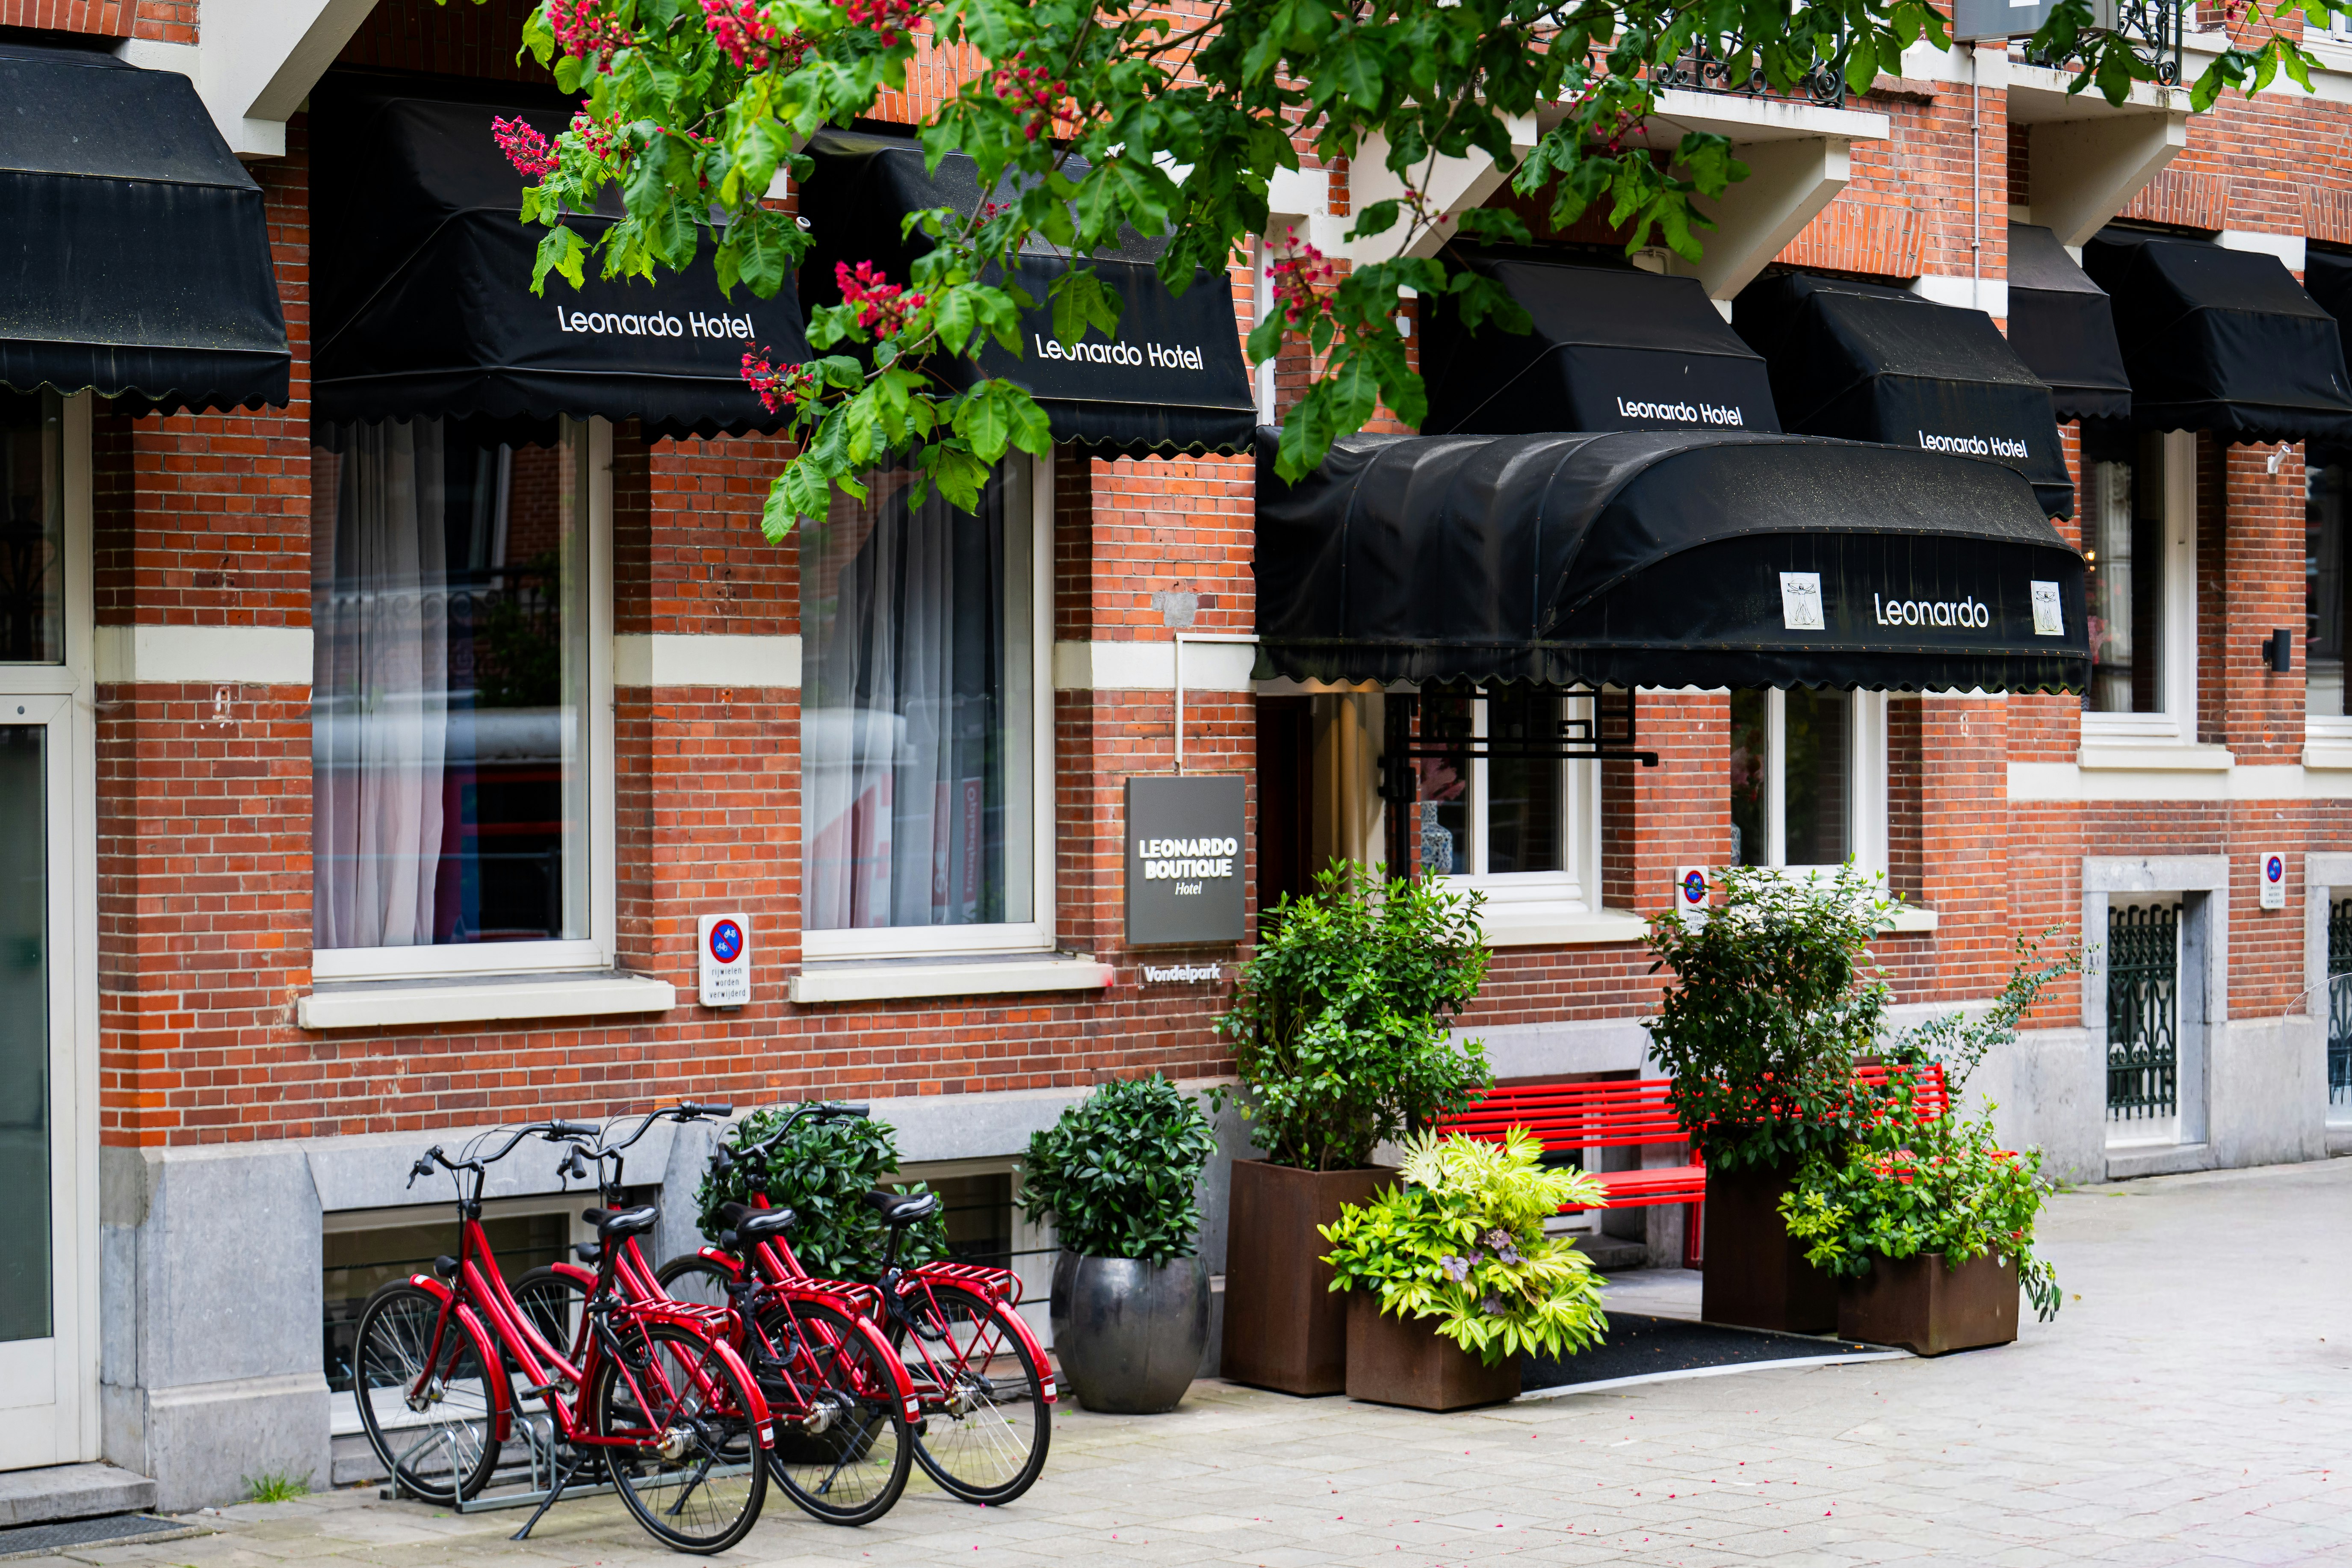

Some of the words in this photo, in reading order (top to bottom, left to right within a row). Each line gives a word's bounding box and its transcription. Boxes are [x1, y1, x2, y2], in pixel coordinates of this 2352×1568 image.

[557, 306, 683, 337] Leonardo
[689, 312, 755, 339] Hotel
[1035, 334, 1142, 366] Leonardo
[1147, 343, 1203, 370] Hotel
[1617, 397, 1698, 422] Leonardo
[1699, 403, 1743, 426] Hotel
[1918, 430, 1988, 455] Leonardo
[1990, 437, 2028, 458] Hotel
[1874, 593, 1989, 628] Leonardo
[1139, 837, 1238, 859] LEONARDO
[1145, 859, 1233, 880] BOUTIQUE
[1175, 881, 1203, 896] Hotel
[712, 966, 742, 977] rijwielen
[1144, 963, 1221, 984] Vondelpark
[709, 989, 746, 1000] verwijderd
